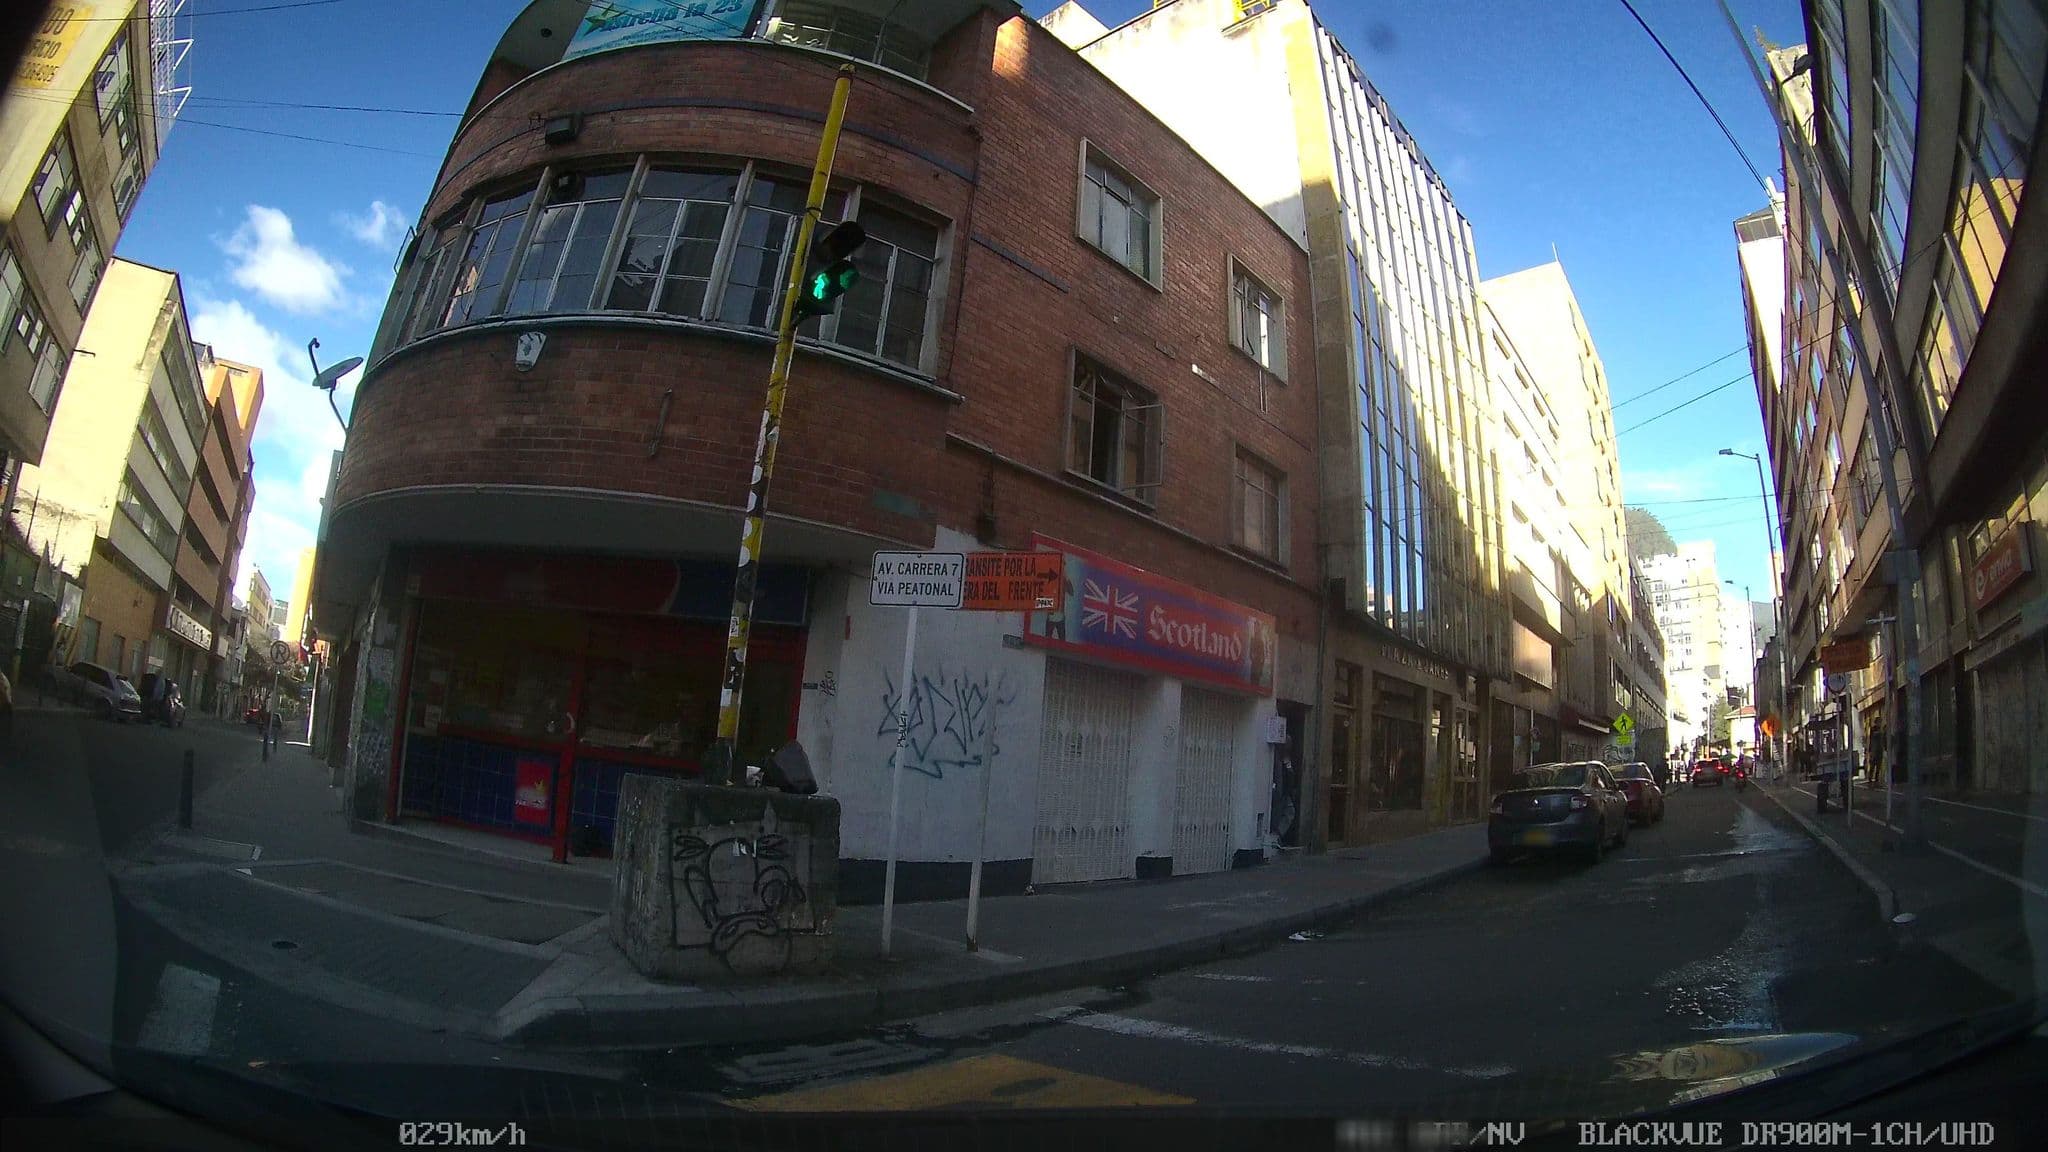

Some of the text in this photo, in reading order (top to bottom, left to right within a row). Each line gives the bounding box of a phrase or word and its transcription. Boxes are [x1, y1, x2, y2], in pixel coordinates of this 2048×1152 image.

[877, 562, 959, 576] AV. CARRERA 7
[1004, 557, 1023, 576] POR
[1025, 557, 1037, 576] LA
[877, 582, 955, 597] VIA PEATONAL
[982, 581, 1000, 600] DEL
[1008, 581, 1044, 601] FRENTE
[1148, 604, 1242, 662] Scotland
